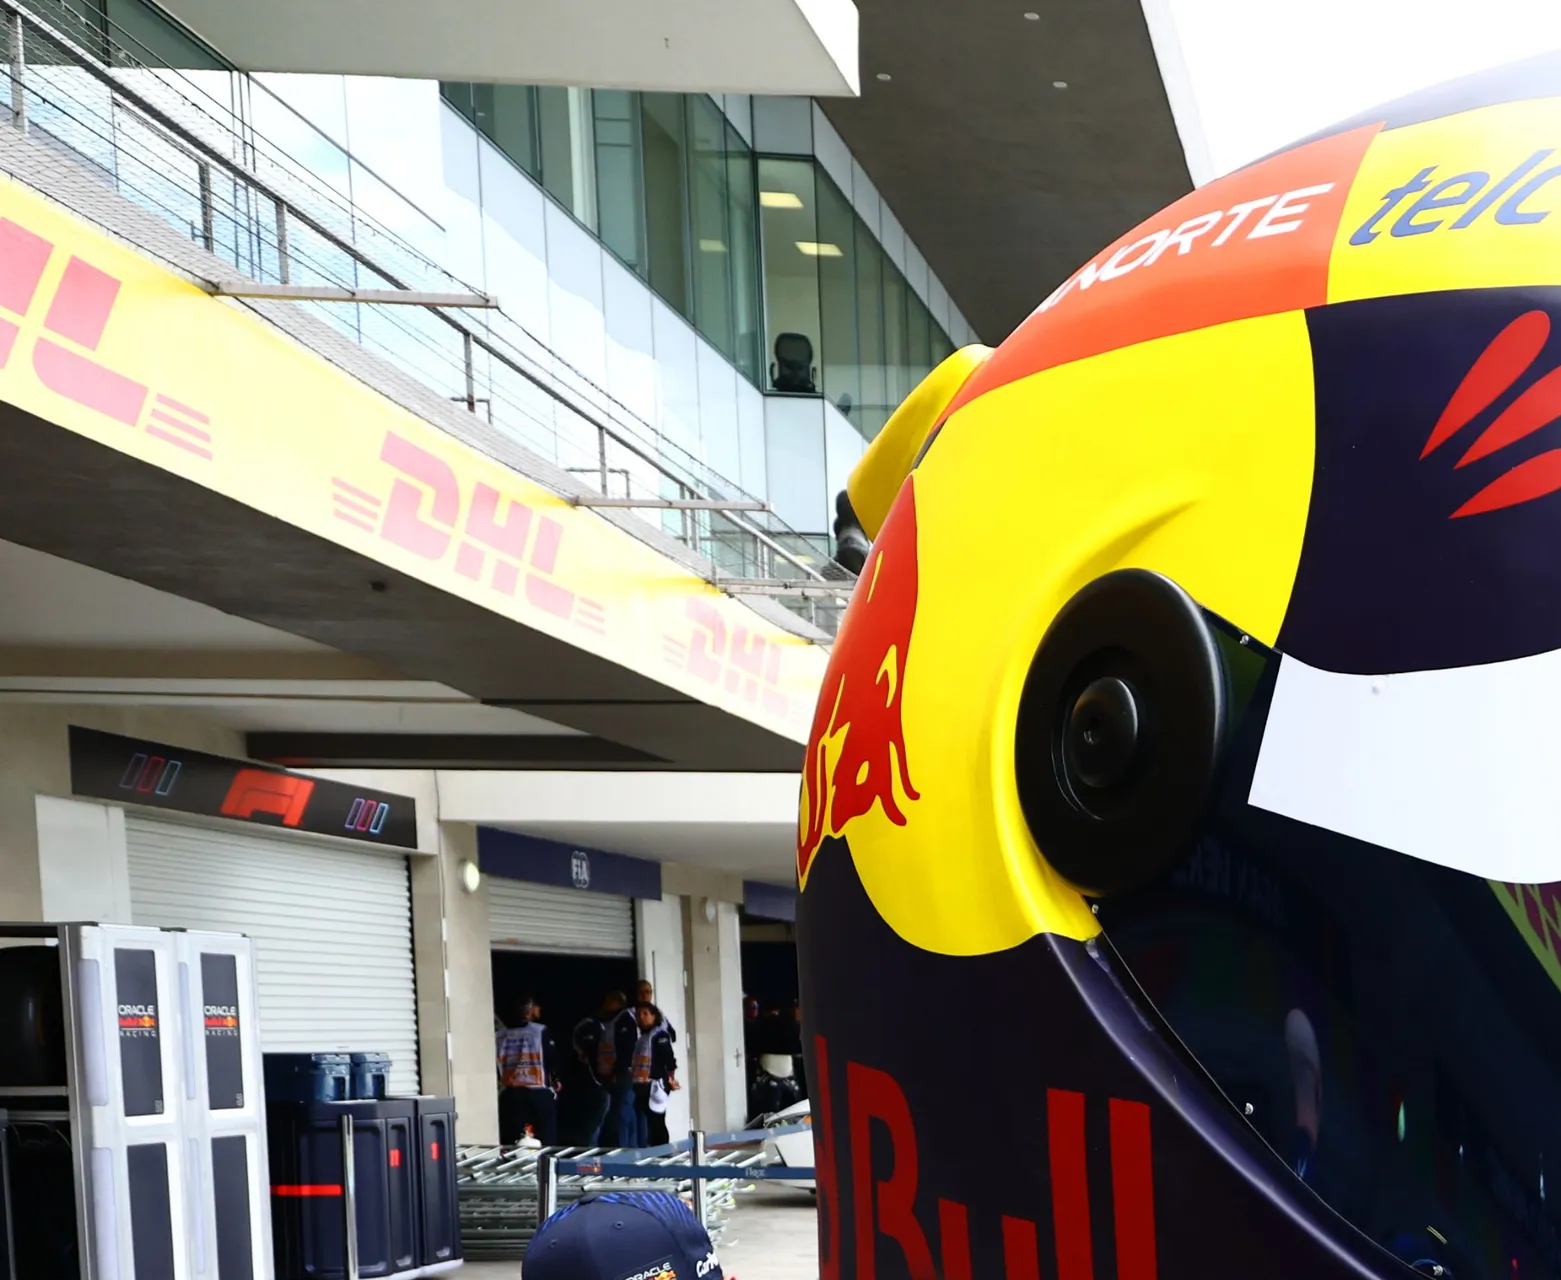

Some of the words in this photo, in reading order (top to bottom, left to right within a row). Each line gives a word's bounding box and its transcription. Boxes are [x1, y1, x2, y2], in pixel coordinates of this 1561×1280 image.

[379, 430, 576, 621] DHL
[685, 595, 791, 719] DHL
[118, 1004, 155, 1016] ORACLE
